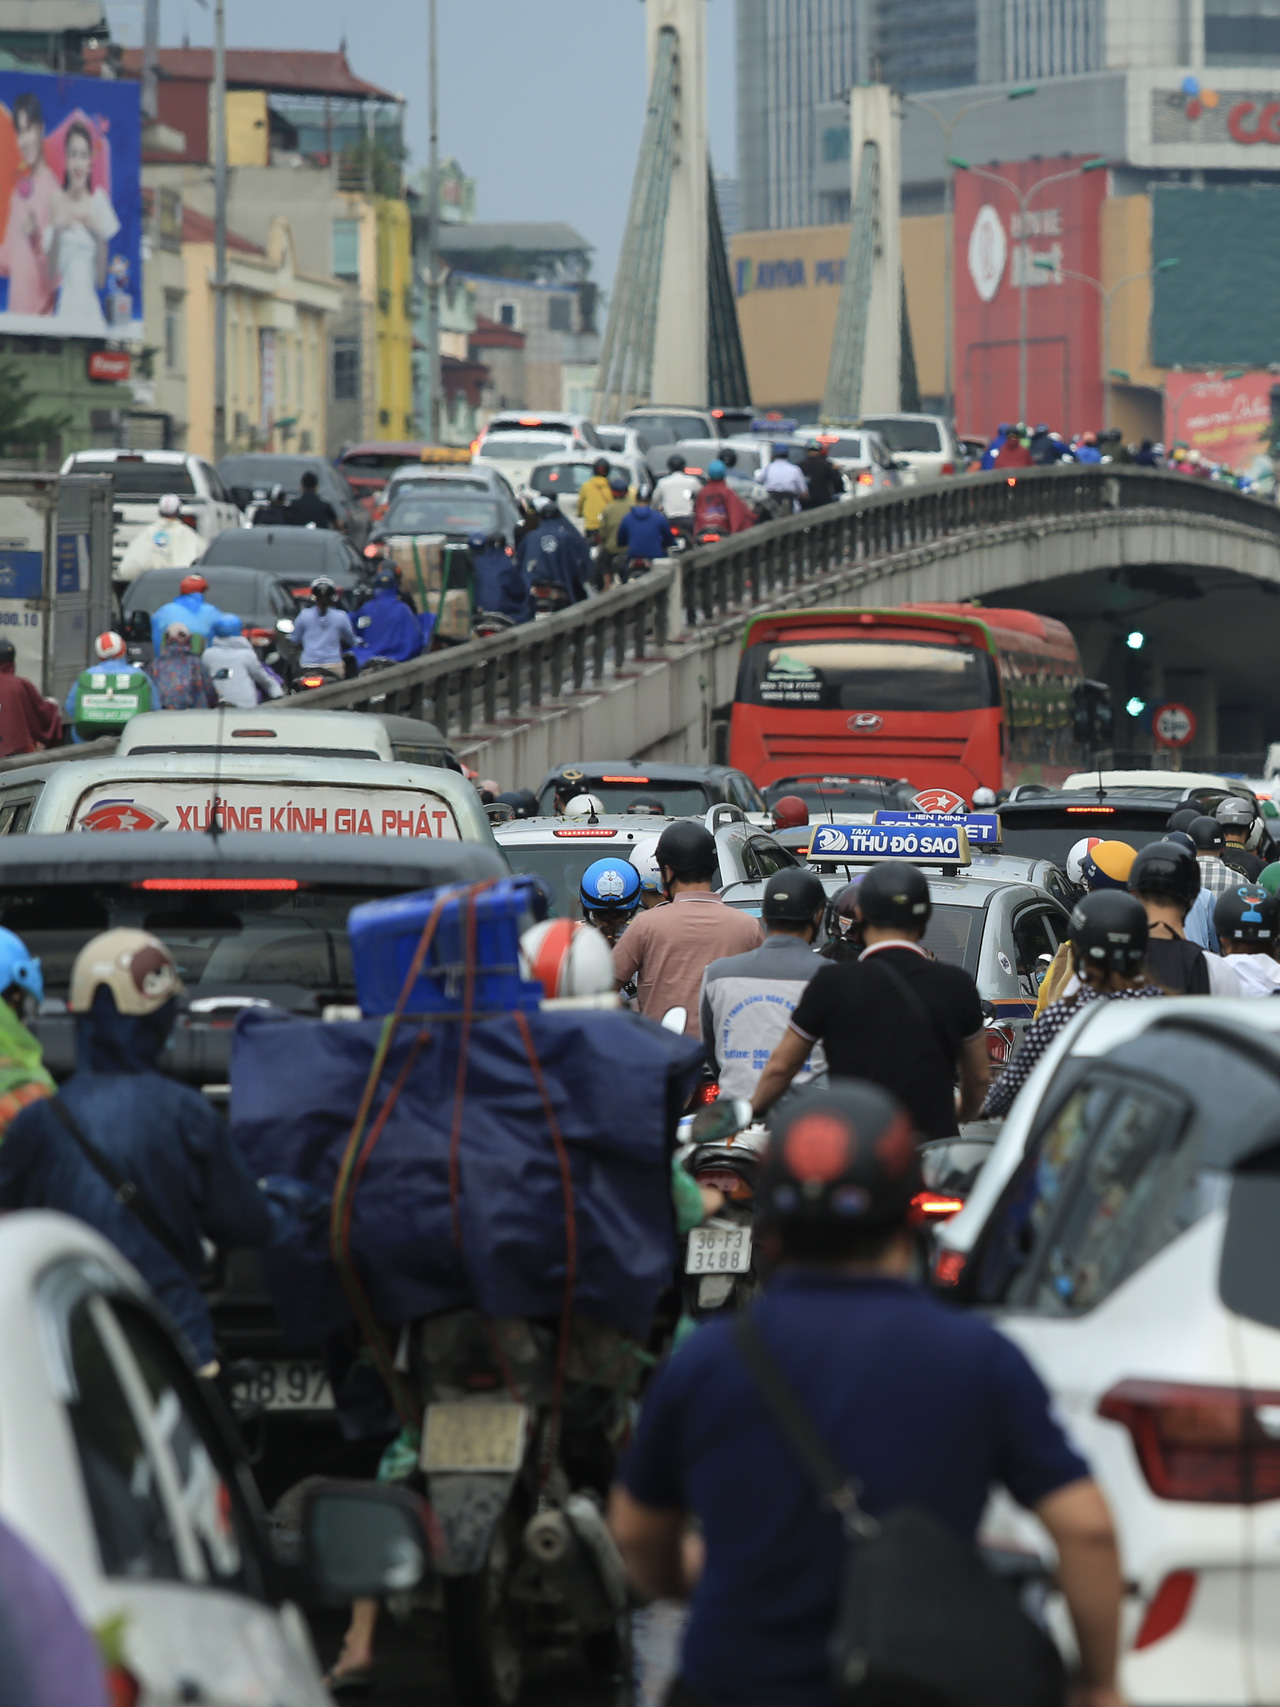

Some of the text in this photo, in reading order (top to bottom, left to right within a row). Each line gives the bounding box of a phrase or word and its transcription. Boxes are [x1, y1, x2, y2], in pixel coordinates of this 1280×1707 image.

[269, 800, 327, 834] KÍNH
[335, 808, 374, 836] GIA
[382, 804, 447, 839] PHÁT
[937, 814, 967, 822] MINH
[851, 828, 871, 836] TAXI
[850, 831, 957, 854] THỦ ĐÔ SAO
[697, 1230, 743, 1249] 36-F3
[695, 1251, 740, 1270] 3488
